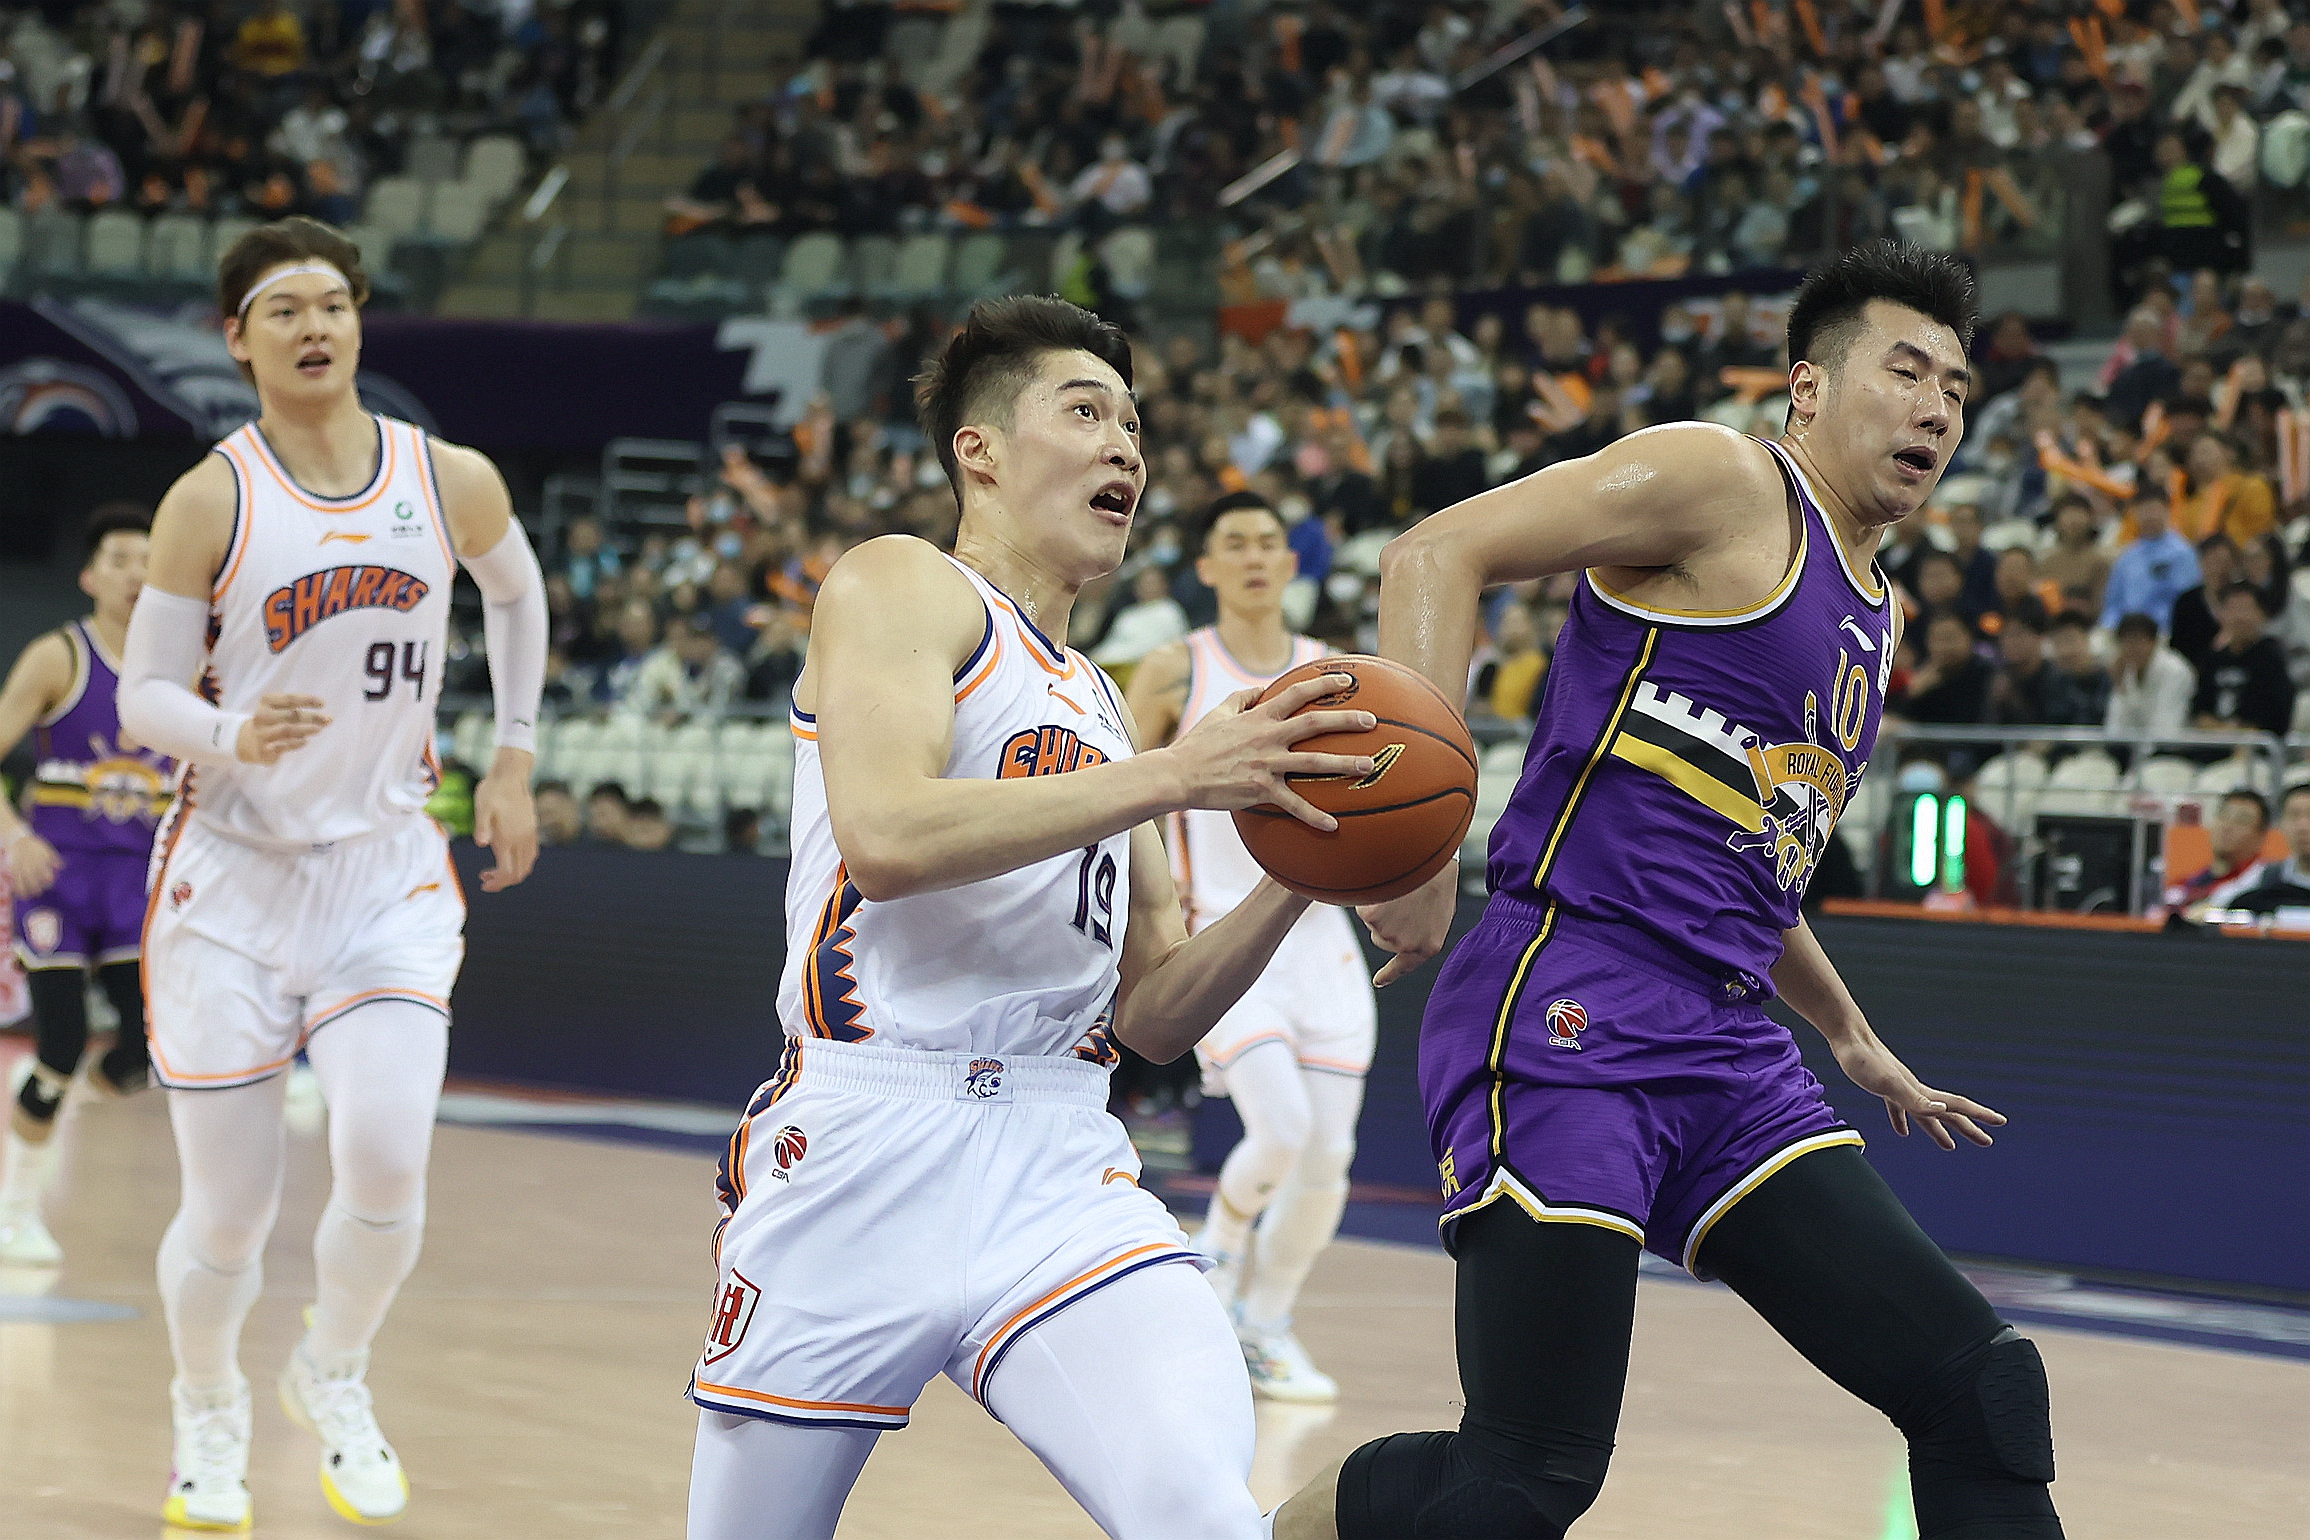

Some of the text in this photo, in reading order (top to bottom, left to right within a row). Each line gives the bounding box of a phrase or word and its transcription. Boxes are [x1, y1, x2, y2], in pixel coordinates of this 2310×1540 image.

[264, 565, 429, 653] SHARKS
[364, 641, 428, 702] 94
[1831, 647, 1868, 752] 10
[996, 724, 1111, 779] SHAR
[1787, 752, 1821, 779] ROYAL
[1070, 842, 1117, 952] 19
[1548, 1036, 1582, 1051] CBA
